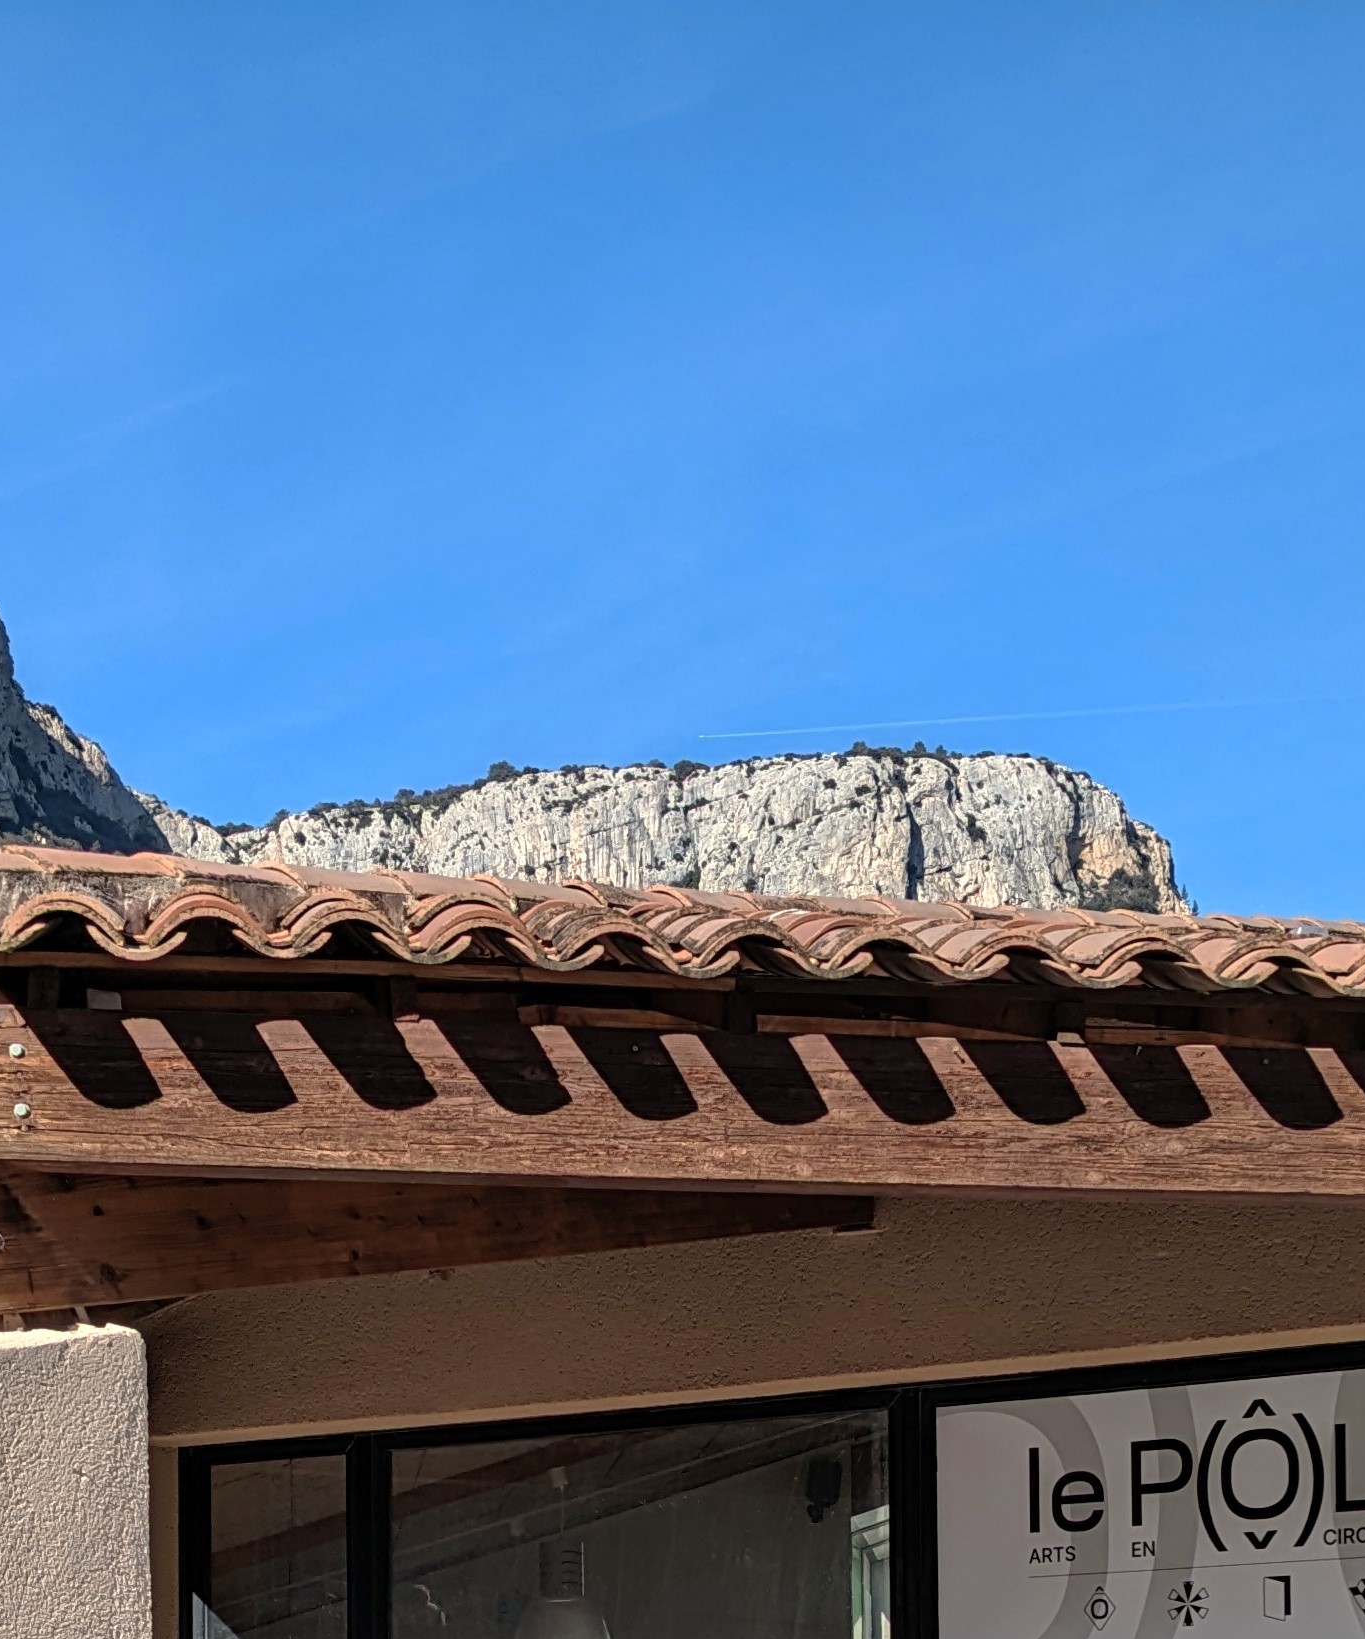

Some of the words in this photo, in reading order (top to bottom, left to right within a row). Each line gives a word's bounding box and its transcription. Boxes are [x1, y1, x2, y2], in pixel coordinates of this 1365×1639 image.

[1028, 1447, 1105, 1533] le
[1029, 1545, 1076, 1564] ARTS
[1132, 1541, 1155, 1558] EN
